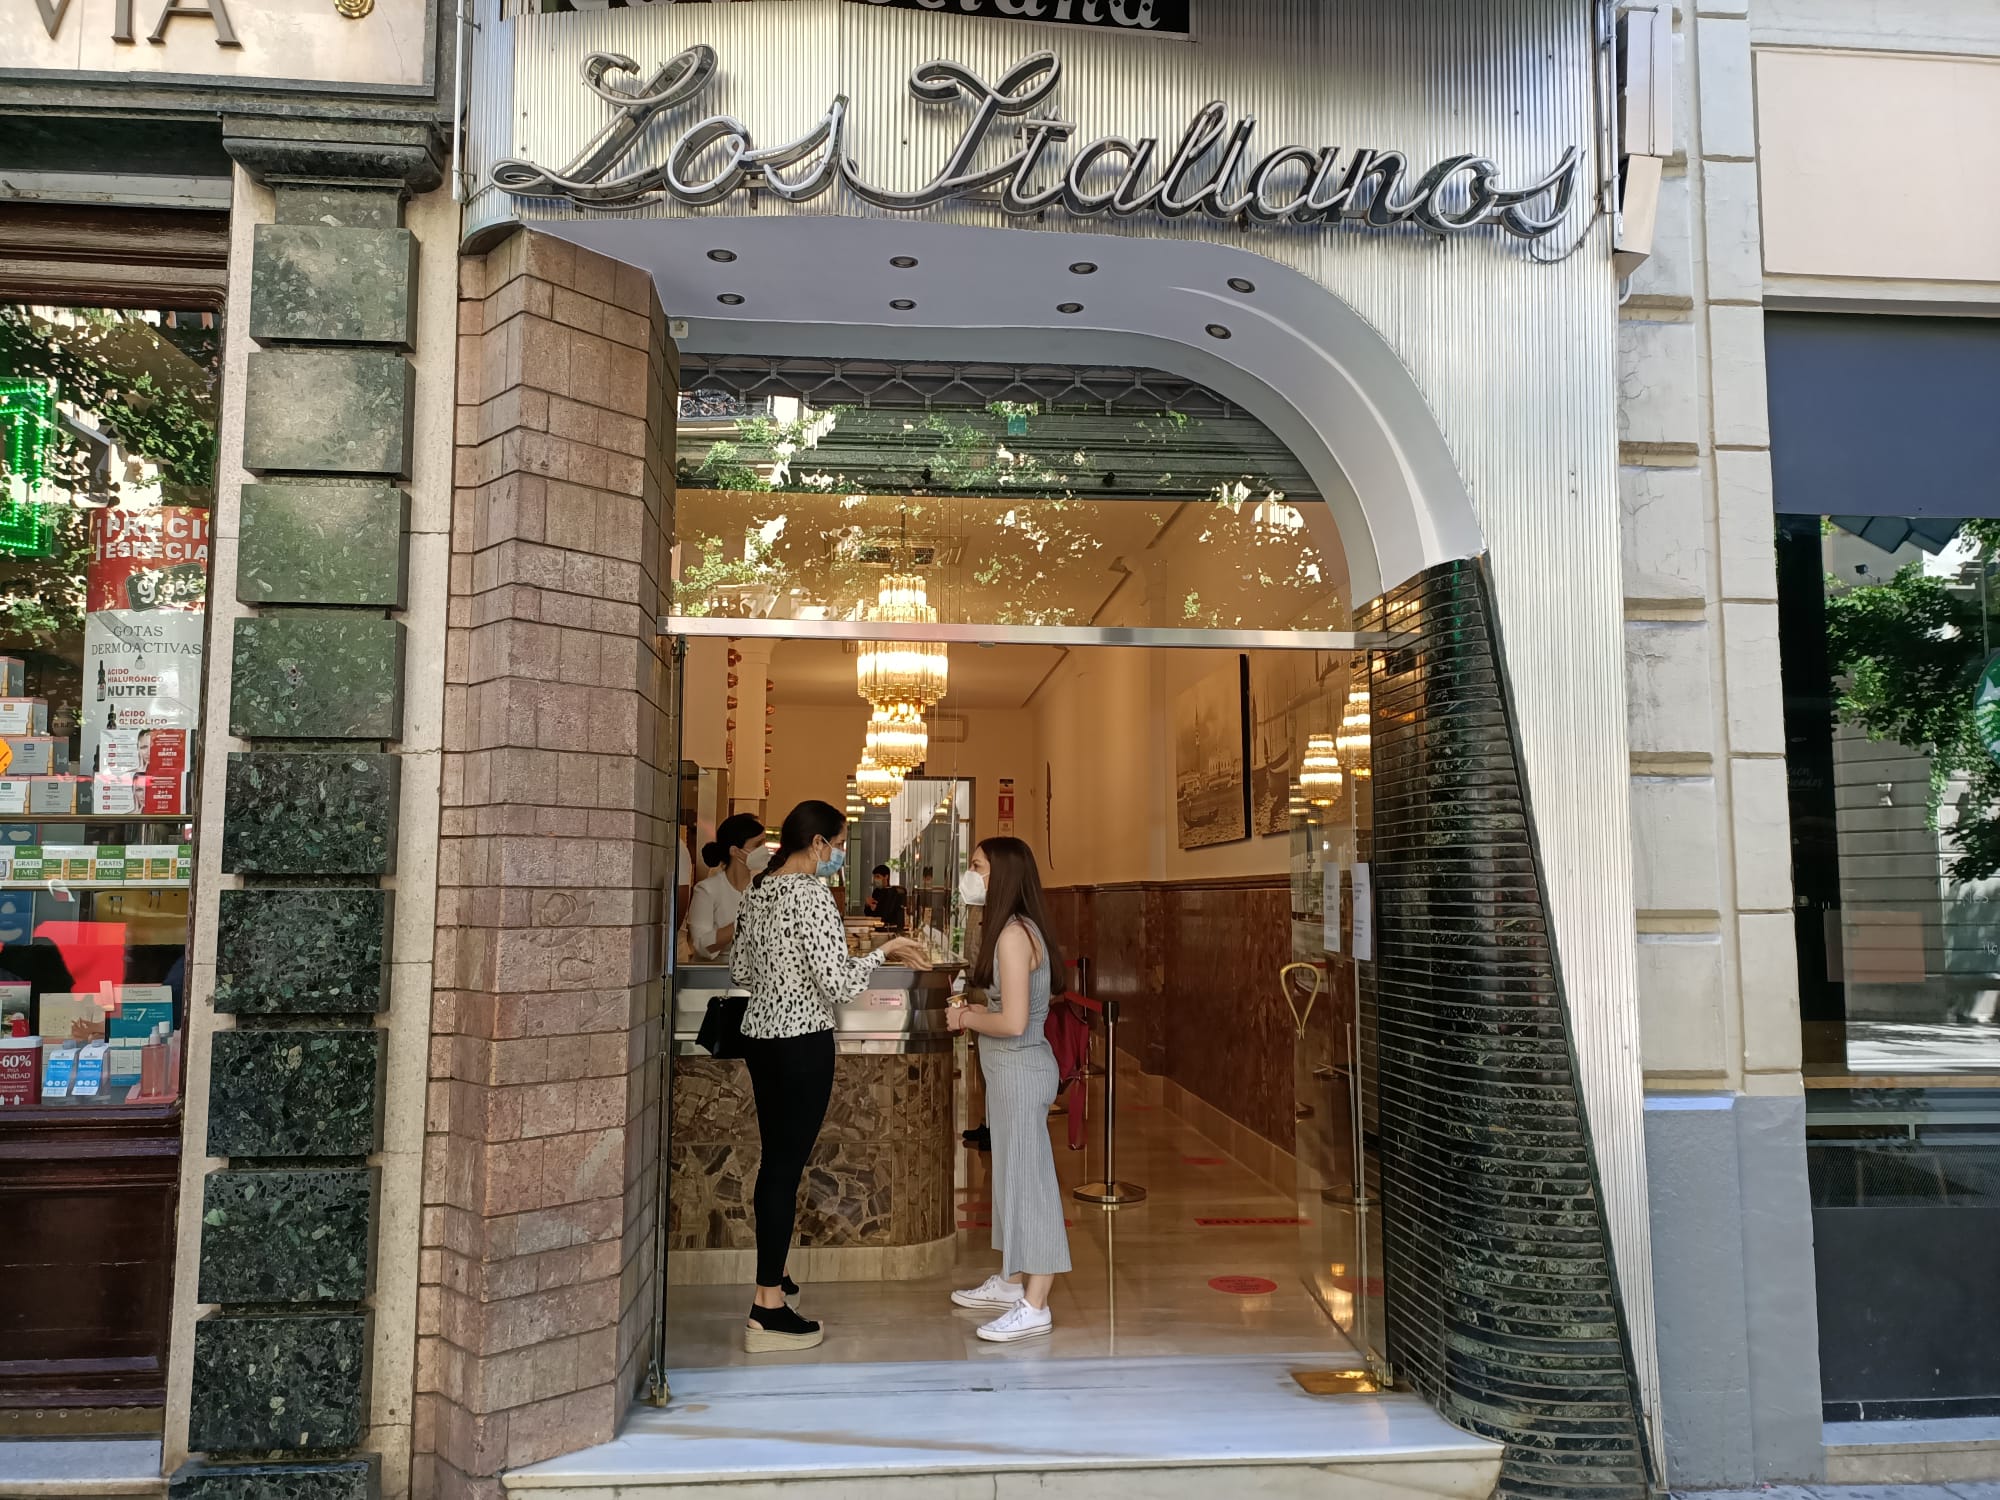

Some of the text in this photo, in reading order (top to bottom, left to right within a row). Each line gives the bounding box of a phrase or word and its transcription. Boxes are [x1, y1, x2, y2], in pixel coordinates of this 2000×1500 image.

[489, 43, 1587, 238] Los Italianos
[113, 625, 163, 637] GOTAS
[91, 642, 202, 655] DERMOACTIVAS
[107, 685, 157, 696] NUTRE
